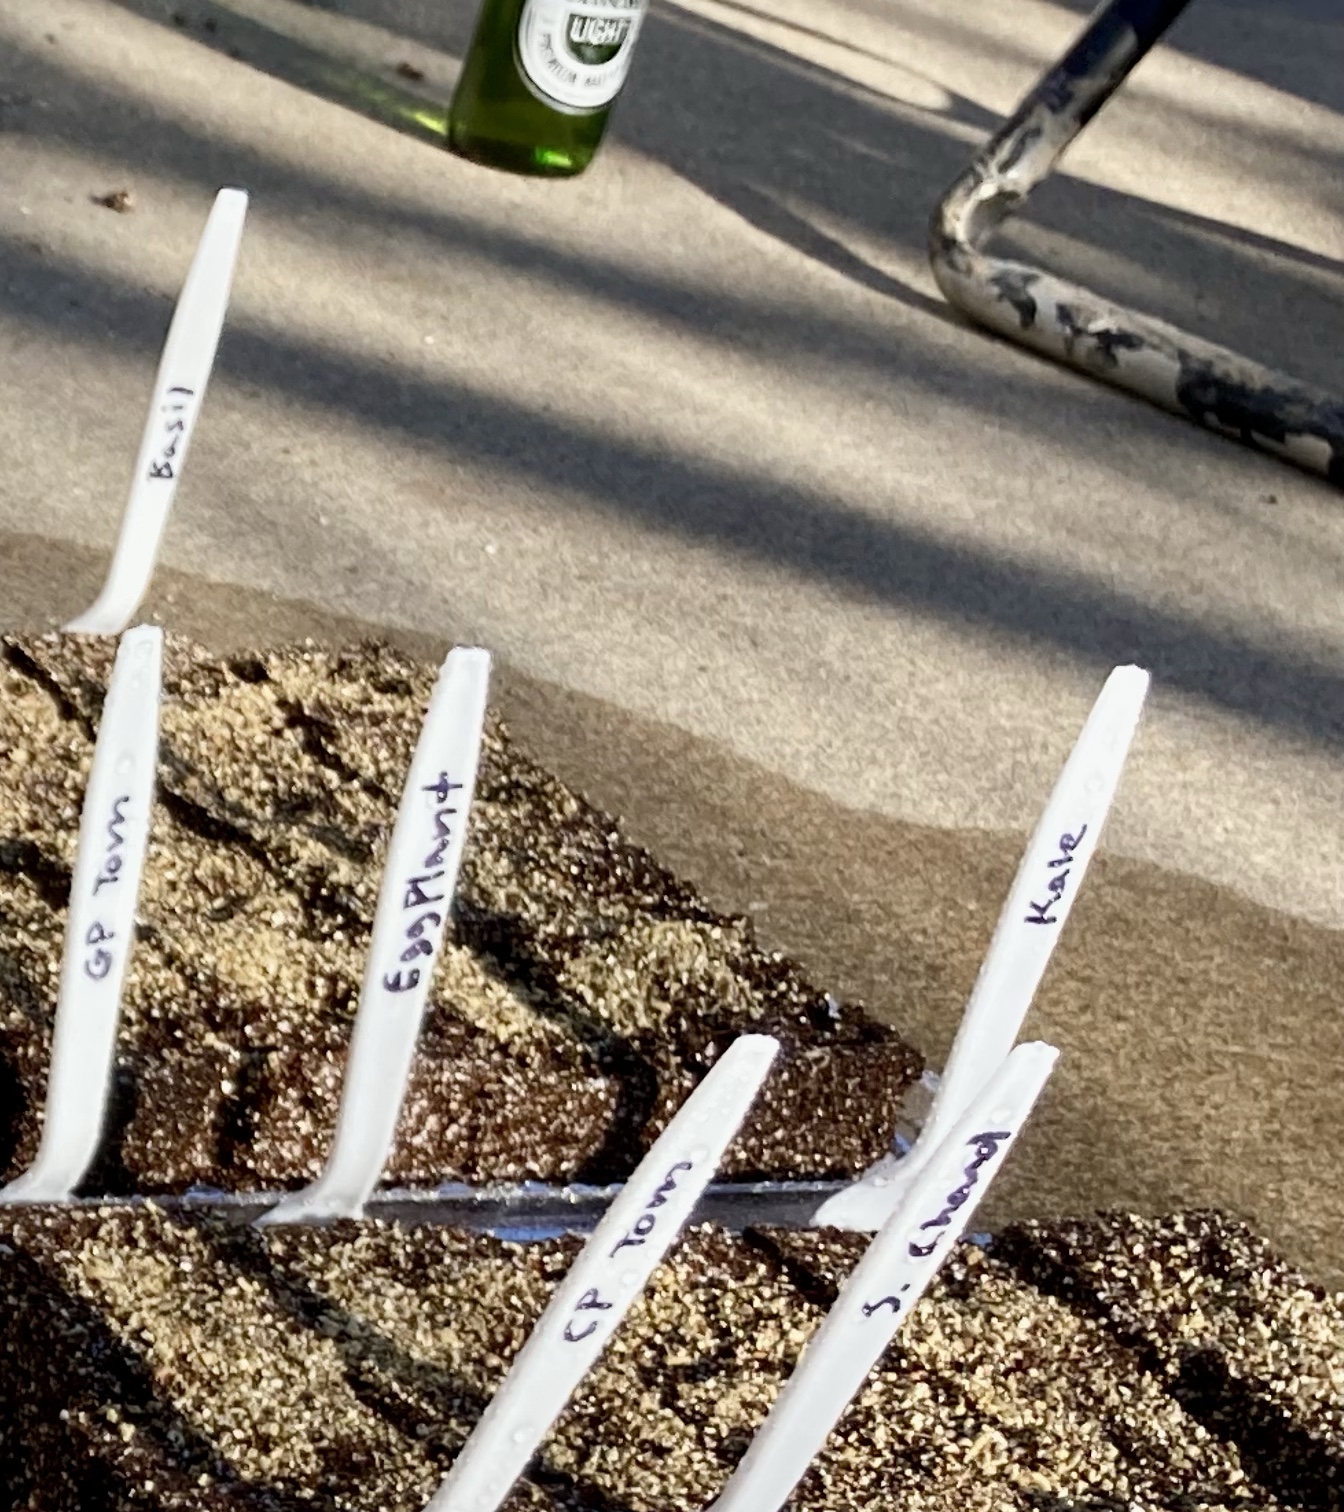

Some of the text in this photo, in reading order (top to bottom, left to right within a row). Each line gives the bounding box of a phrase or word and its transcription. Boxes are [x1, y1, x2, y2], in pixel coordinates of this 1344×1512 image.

[570, 15, 631, 45] LIGHT
[148, 386, 194, 480] Basil
[84, 795, 130, 982] GP Tom
[1023, 823, 1088, 925] Kale
[563, 1160, 693, 1342] CP Tom
[862, 1131, 1012, 1318] S. Chard
